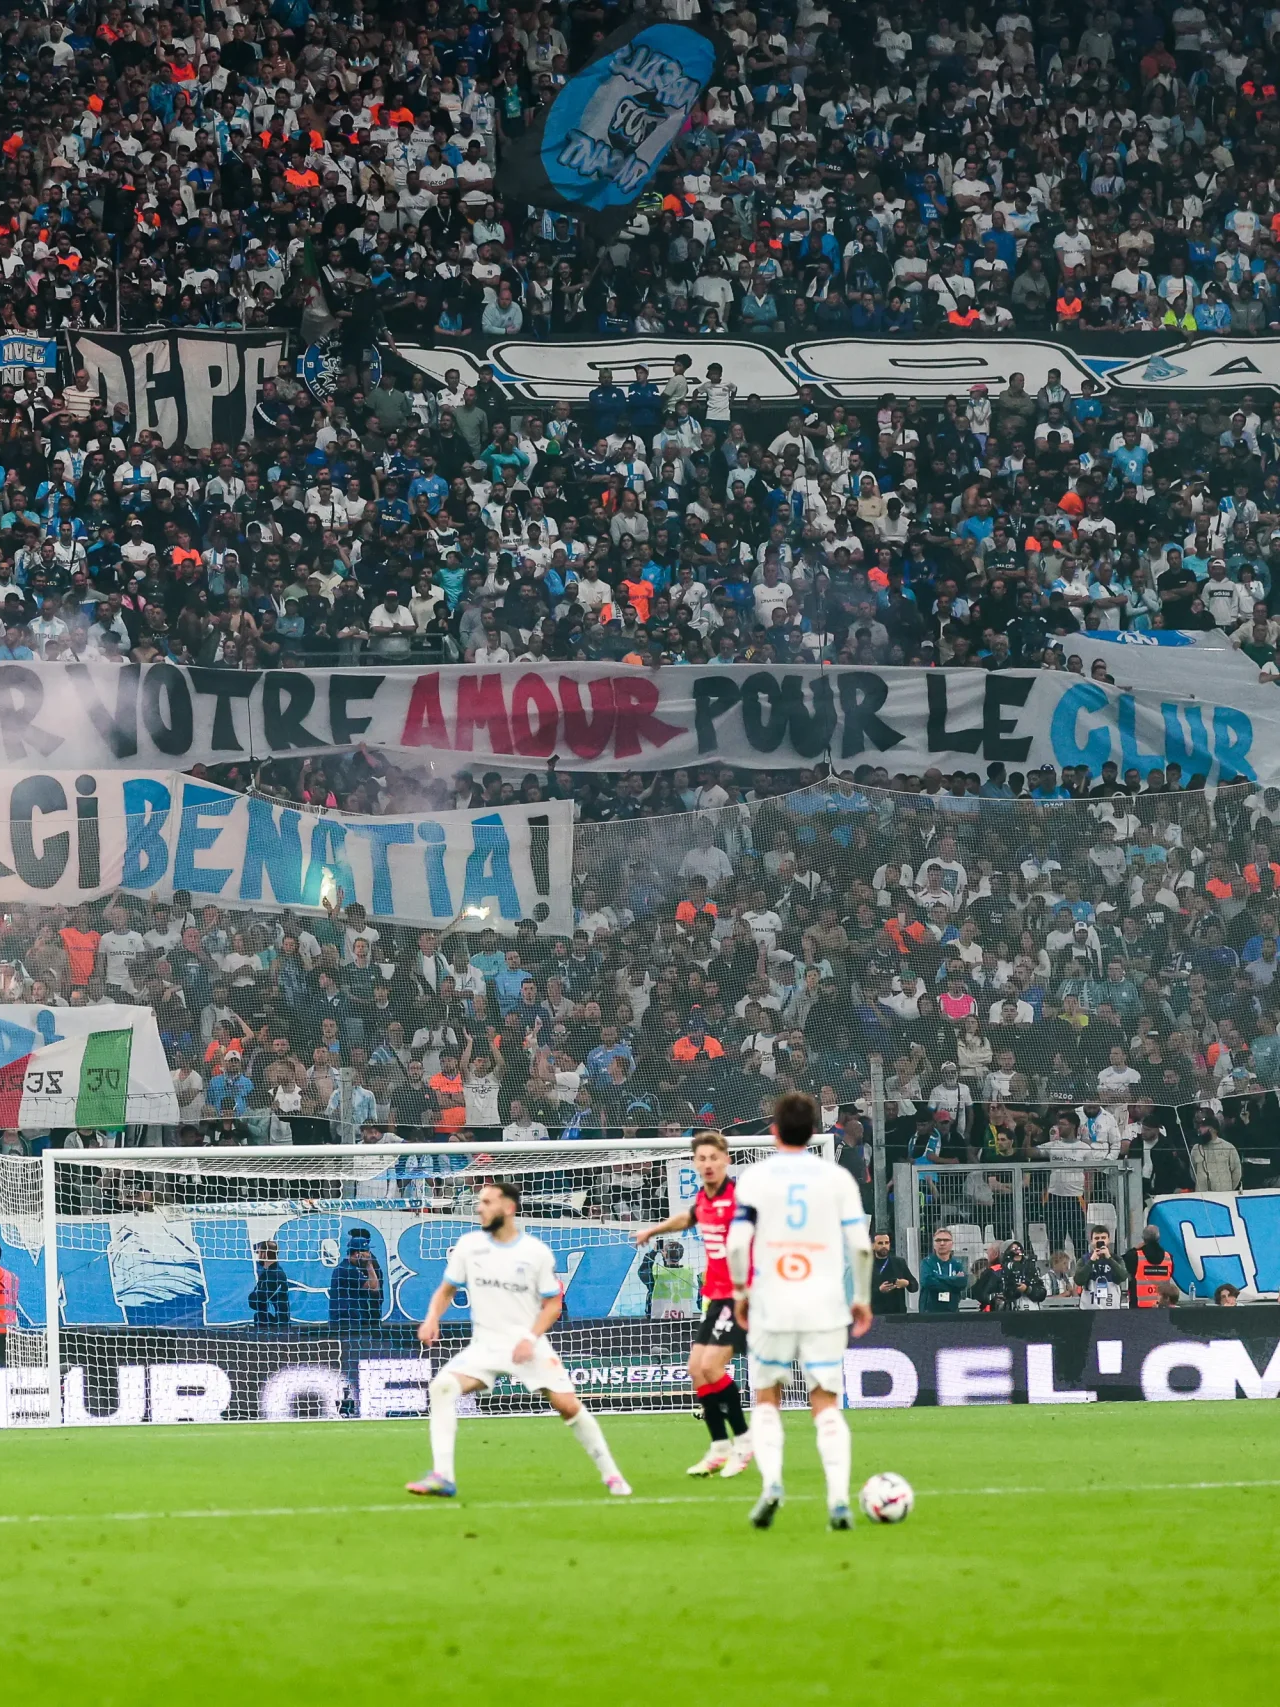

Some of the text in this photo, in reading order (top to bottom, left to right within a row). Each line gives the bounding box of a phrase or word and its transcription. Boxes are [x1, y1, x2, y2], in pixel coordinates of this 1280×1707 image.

[3, 343, 45, 363] AVEC
[2, 367, 46, 387] NOS
[66, 661, 387, 758] VOTRE
[400, 671, 689, 759] AMOUR
[693, 671, 907, 758] POUR
[926, 672, 1037, 762] LE
[785, 1183, 808, 1231] 5
